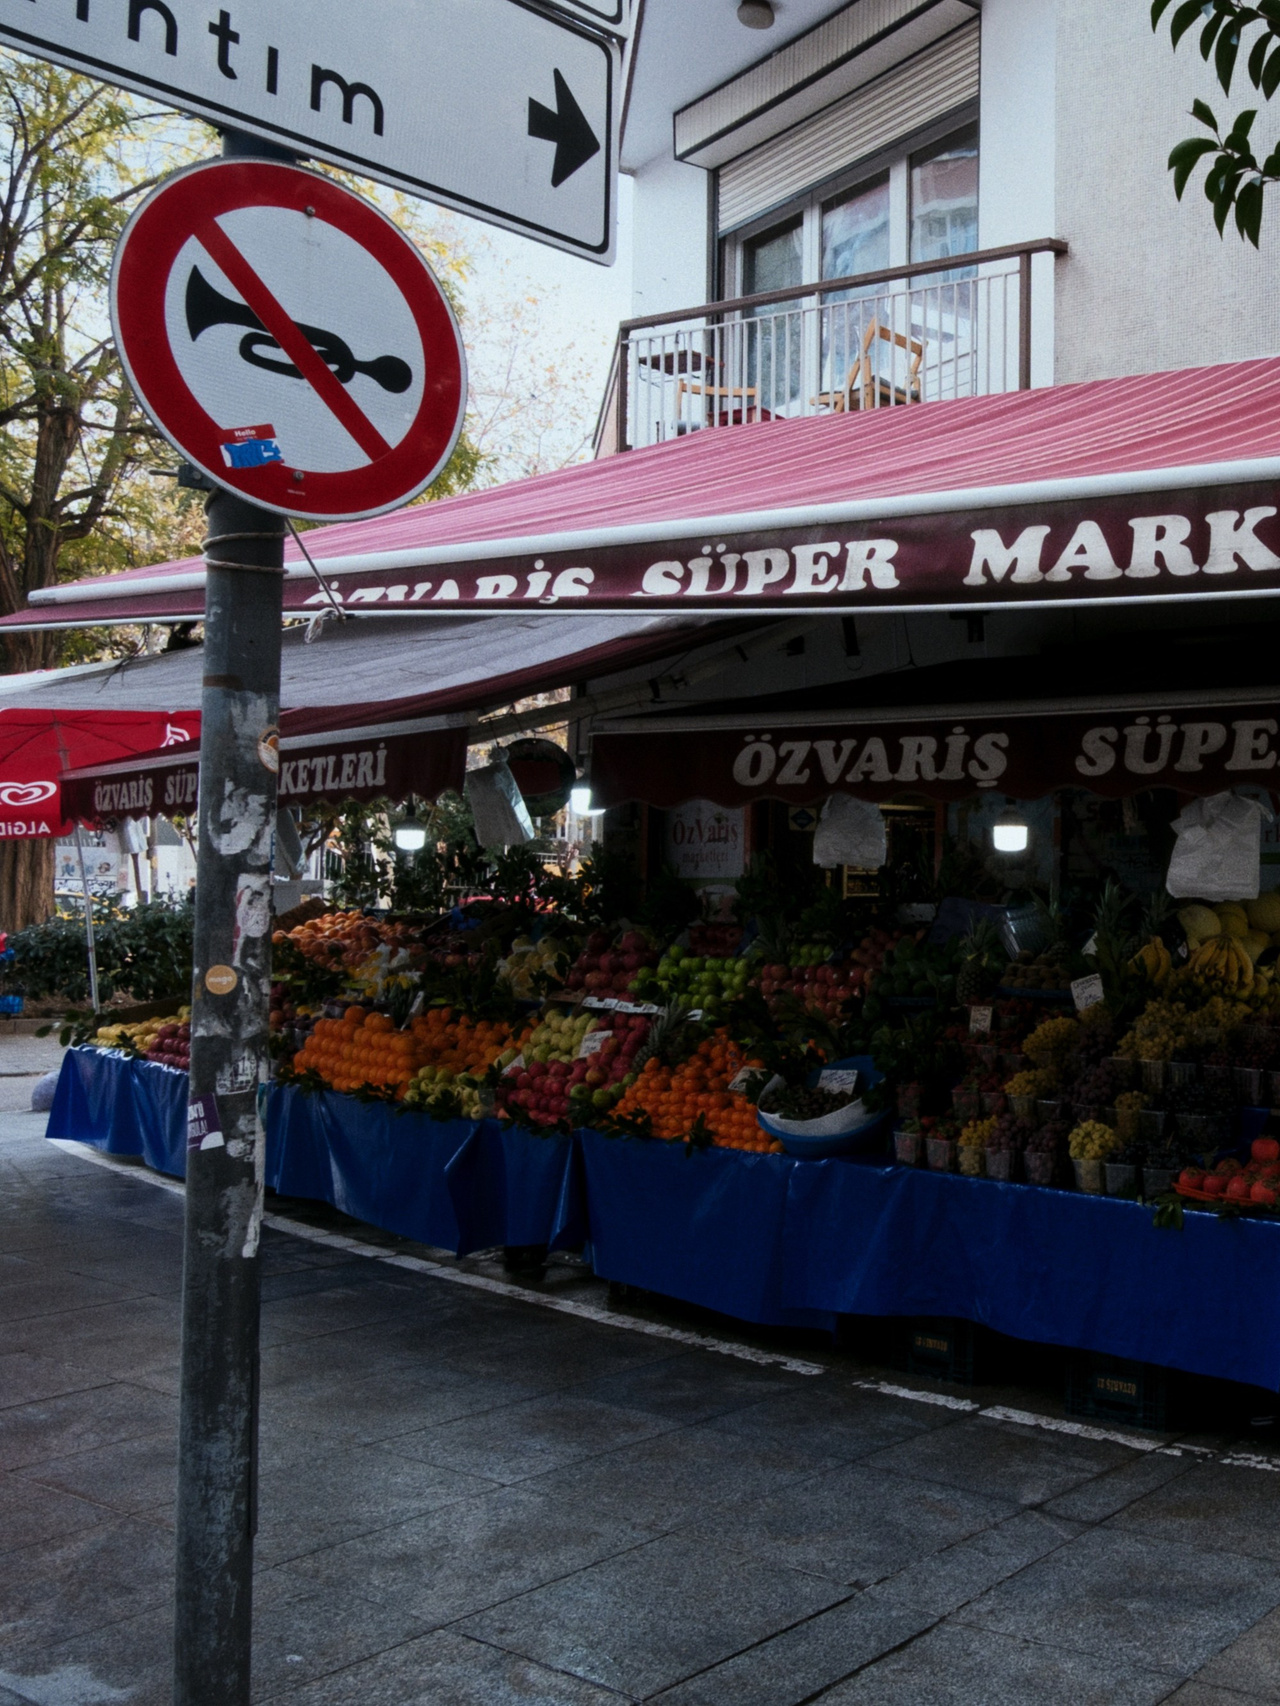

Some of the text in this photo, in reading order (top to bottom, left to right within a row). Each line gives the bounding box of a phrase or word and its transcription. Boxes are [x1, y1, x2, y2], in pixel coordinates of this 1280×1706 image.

[234, 429, 256, 437] Hello
[633, 539, 900, 597] SÜPER
[94, 774, 154, 812] ÖZVARİŞ
[164, 769, 197, 805] SÜP
[278, 742, 388, 795] KETLERİ
[732, 726, 1010, 788] ÖZVARİŞ
